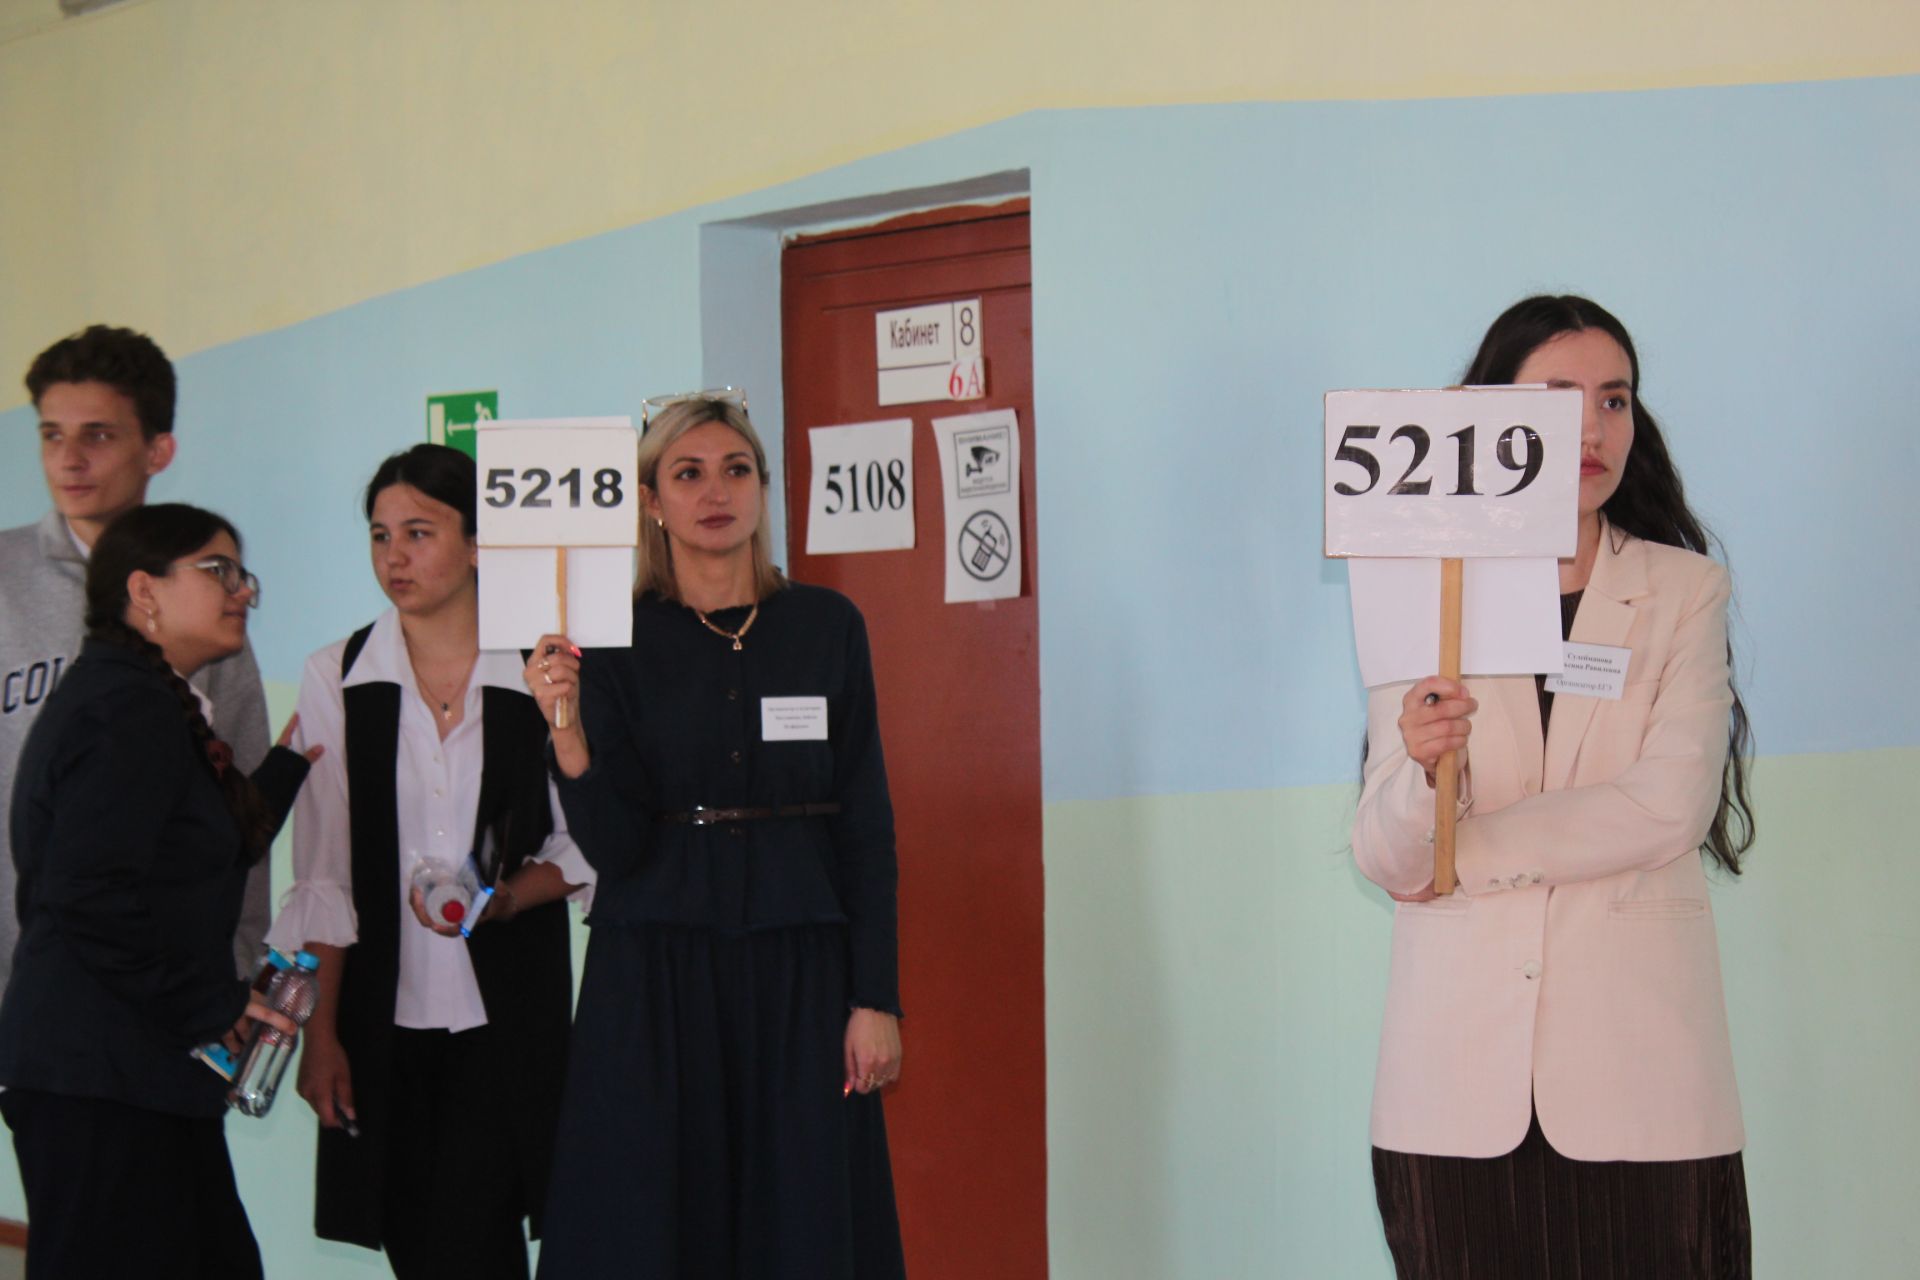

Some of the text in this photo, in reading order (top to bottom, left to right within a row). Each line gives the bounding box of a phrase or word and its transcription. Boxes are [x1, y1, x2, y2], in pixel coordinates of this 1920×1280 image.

[889, 306, 975, 349] Кабинет 8
[1333, 424, 1545, 497] 5219
[484, 467, 624, 509] 5218
[825, 458, 906, 514] 5108
